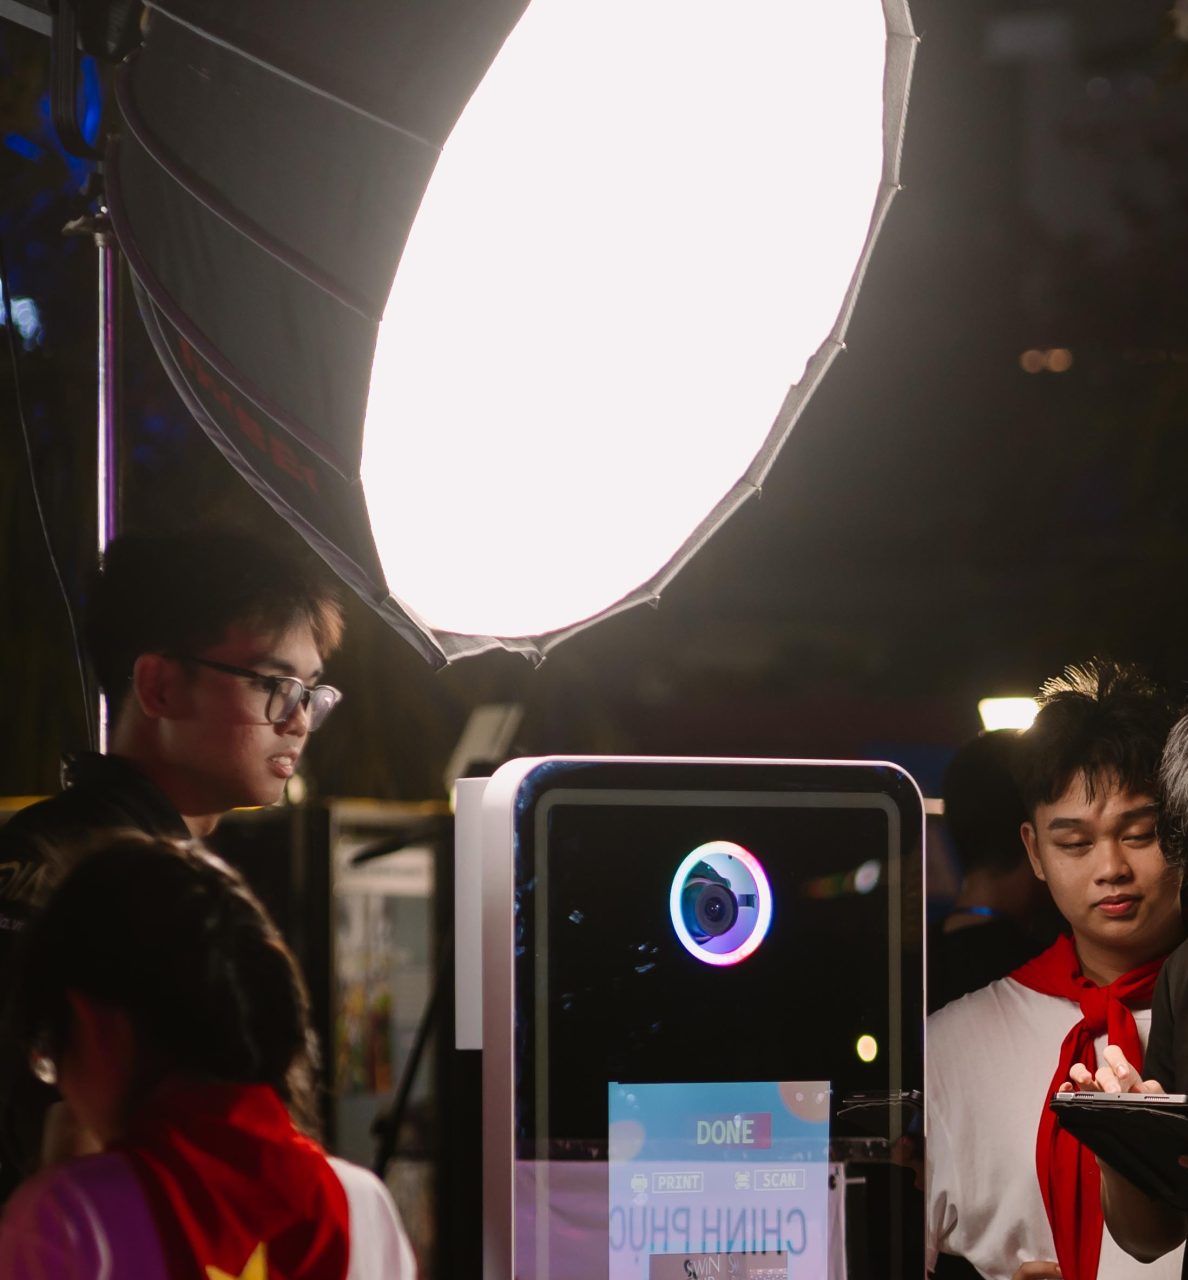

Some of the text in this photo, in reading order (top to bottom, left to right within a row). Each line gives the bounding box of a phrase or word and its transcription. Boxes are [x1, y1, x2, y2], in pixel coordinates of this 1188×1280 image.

[696, 1119, 755, 1145] DONE
[657, 1172, 797, 1190] PRINT SCAN
